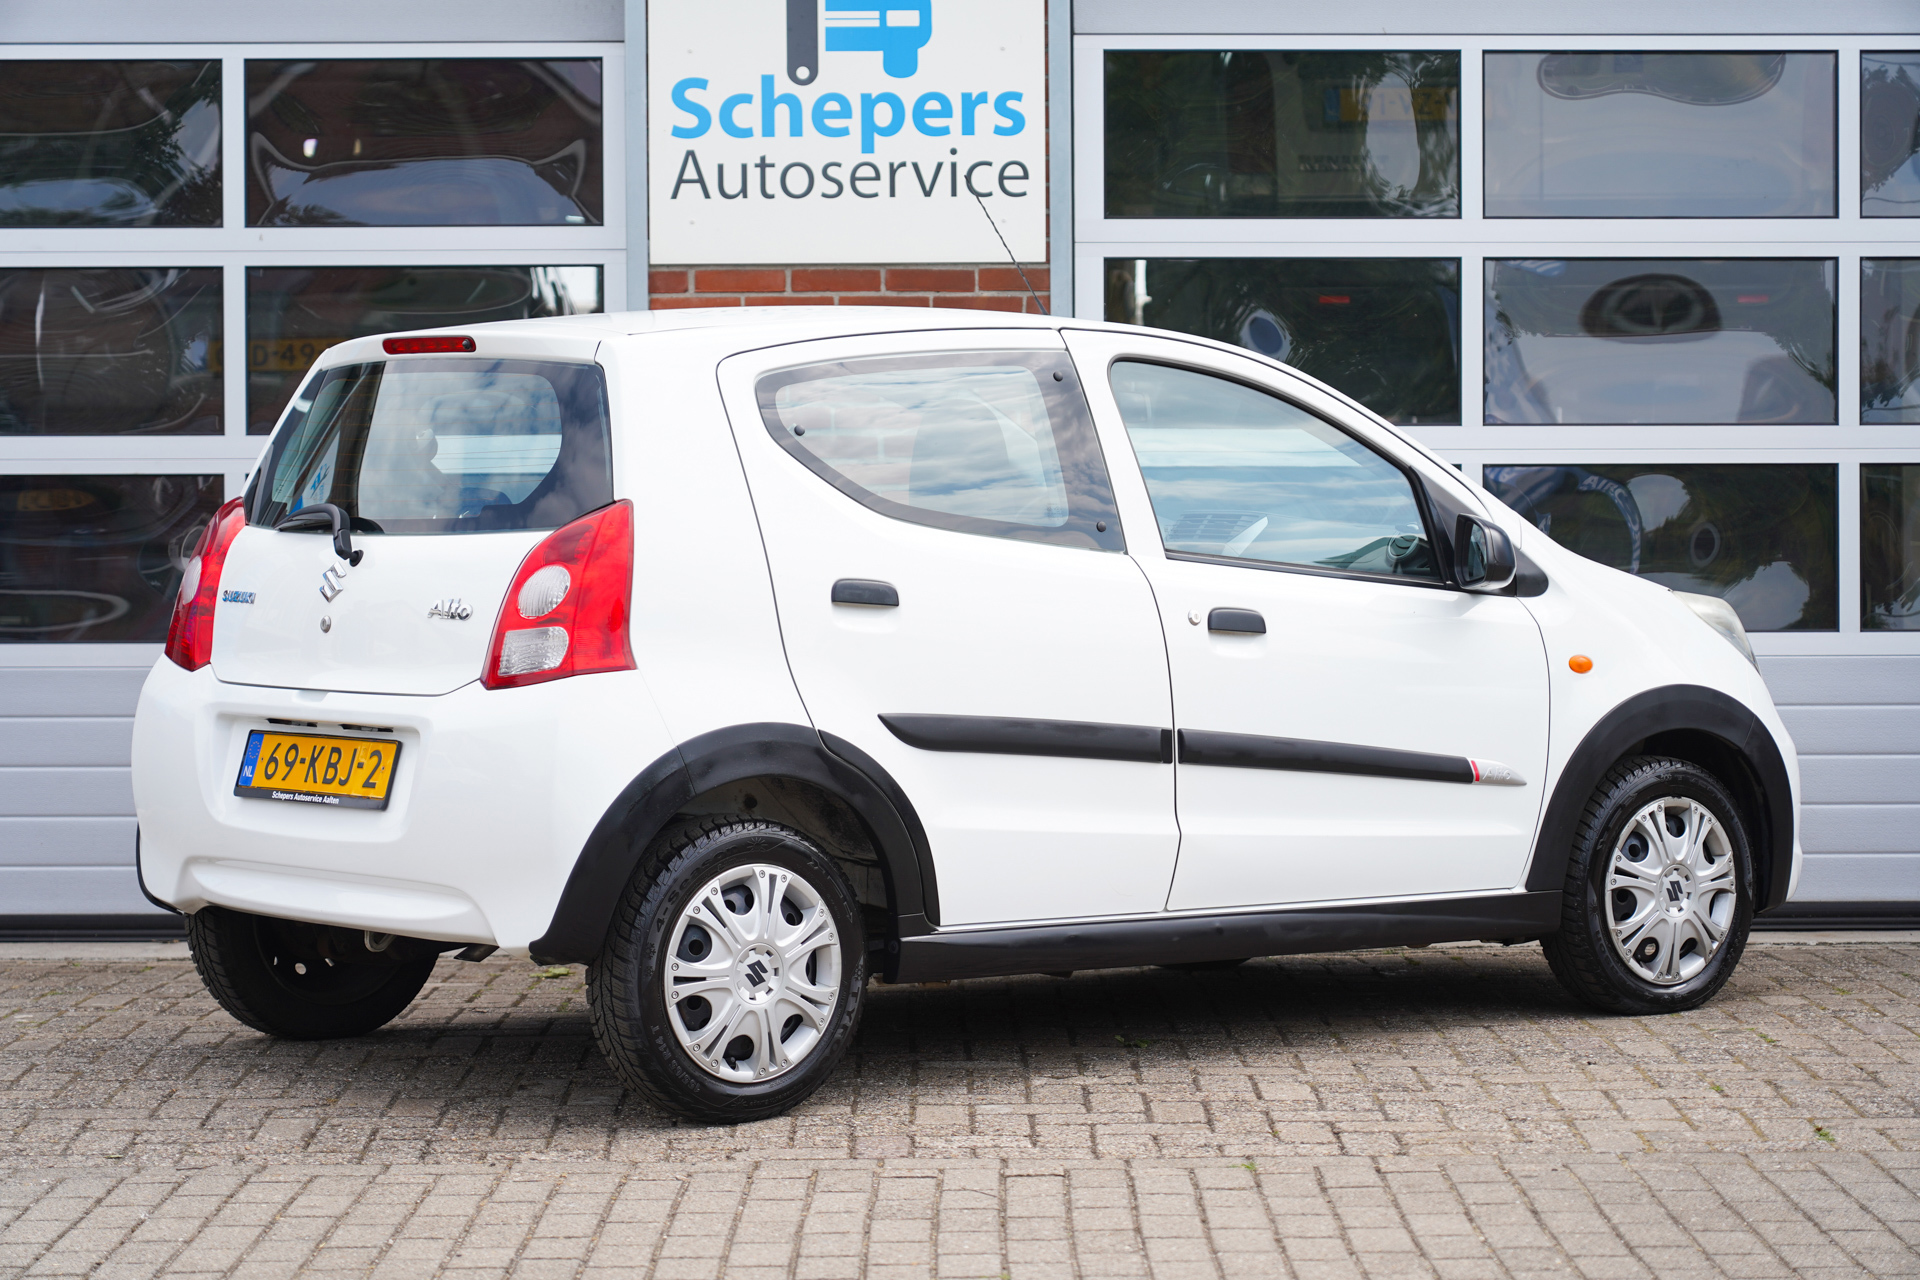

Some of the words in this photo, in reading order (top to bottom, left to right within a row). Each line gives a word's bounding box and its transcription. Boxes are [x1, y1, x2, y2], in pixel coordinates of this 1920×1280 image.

[671, 74, 1026, 154] Schepers
[670, 147, 1030, 200] Autoservice
[222, 590, 256, 604] SUZUKI
[427, 598, 473, 621] Alto
[243, 764, 253, 777] NL
[264, 742, 383, 789] 69-KBJ-2
[271, 790, 294, 801] Schepers
[293, 793, 323, 803] Autoservice
[322, 795, 340, 805] Aalten
